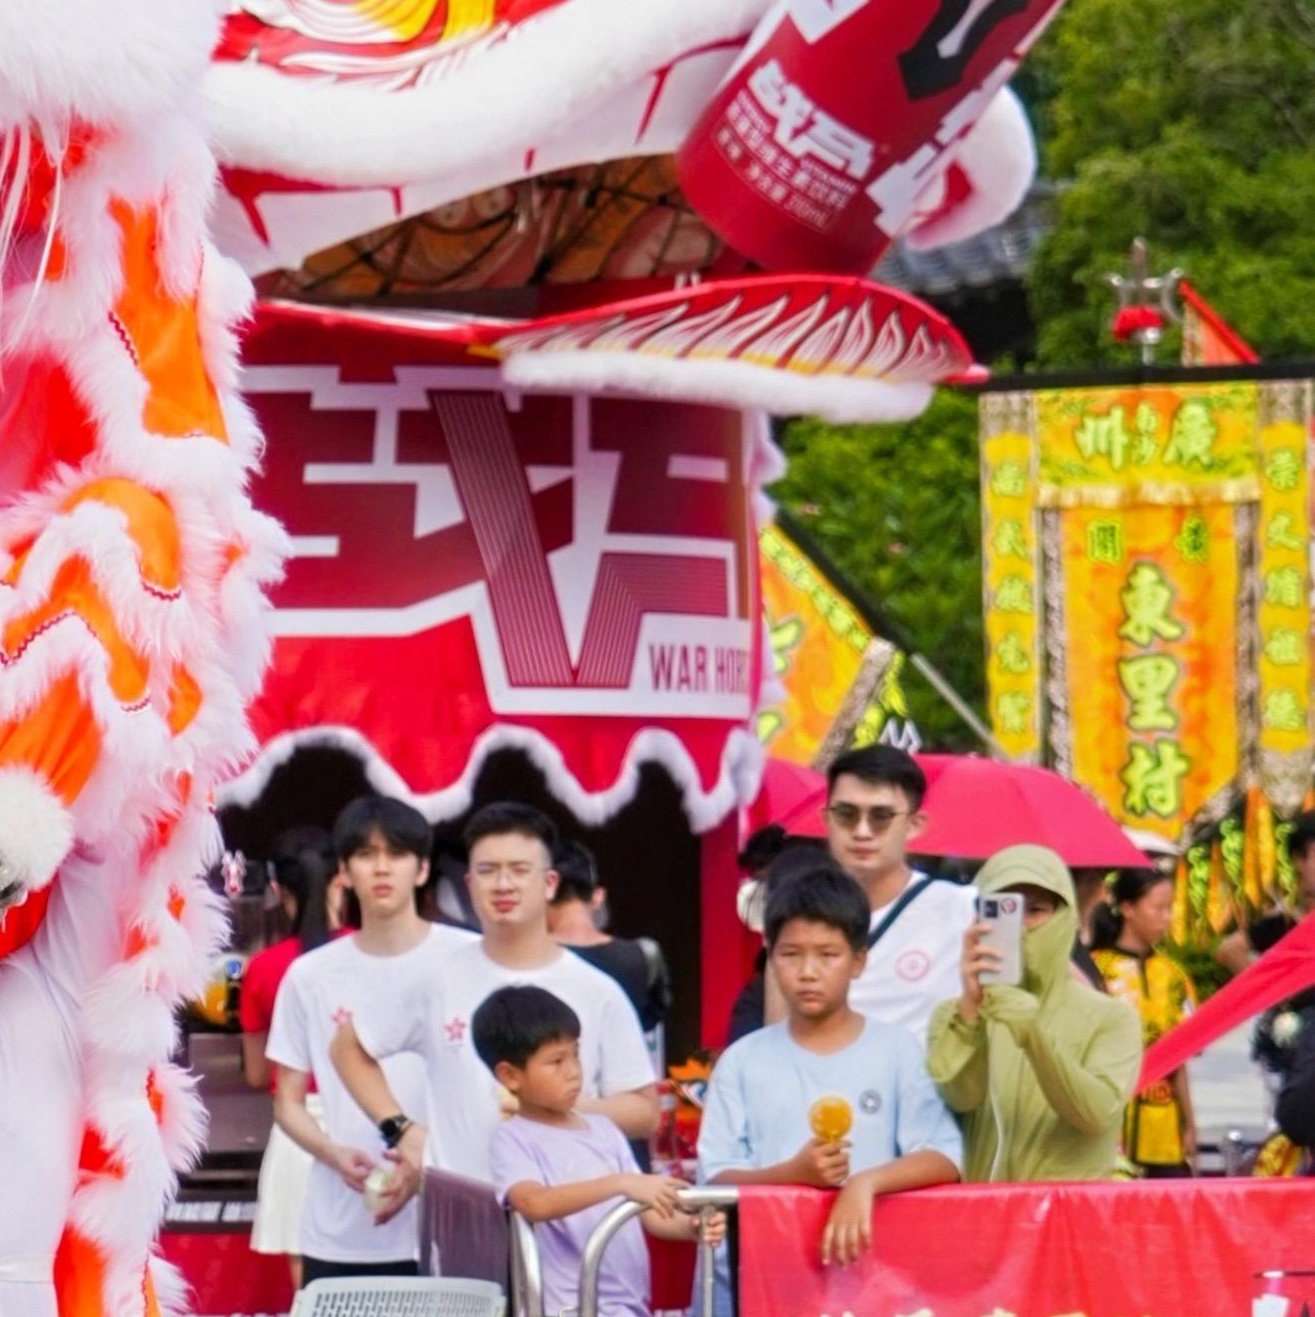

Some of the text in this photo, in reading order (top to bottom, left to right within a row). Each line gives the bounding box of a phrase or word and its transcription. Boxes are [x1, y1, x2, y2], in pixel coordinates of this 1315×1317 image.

[746, 58, 875, 182] 战马
[648, 644, 709, 691] WAR
[1118, 562, 1191, 819] 東里村
